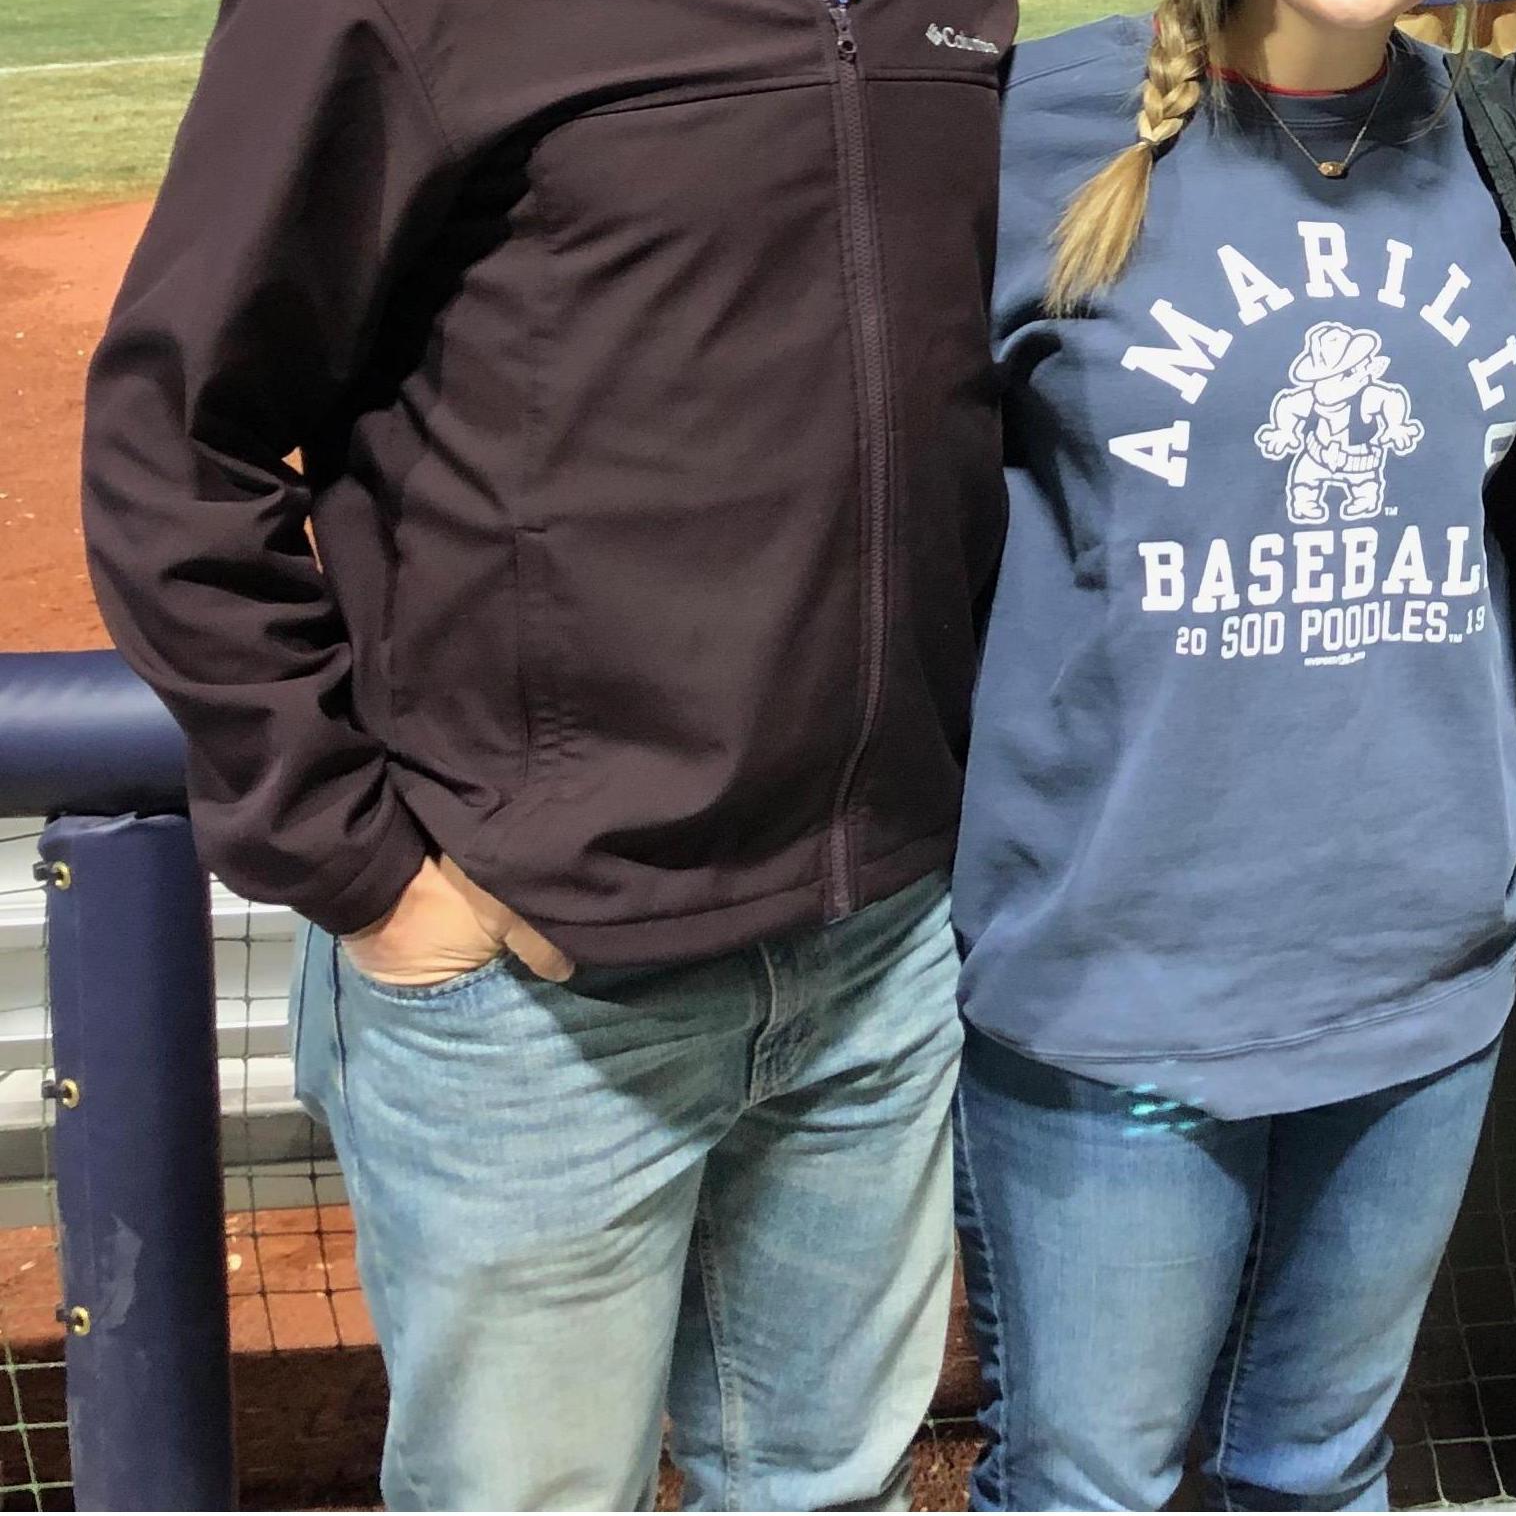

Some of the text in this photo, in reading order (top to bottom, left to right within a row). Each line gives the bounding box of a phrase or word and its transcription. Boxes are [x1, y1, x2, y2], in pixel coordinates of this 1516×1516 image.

[1138, 525, 1488, 612] BASEBAL
[1175, 626, 1207, 656] 20
[1221, 611, 1285, 659] SOD
[1300, 600, 1449, 653] POODLES
[1466, 605, 1485, 635] 19
